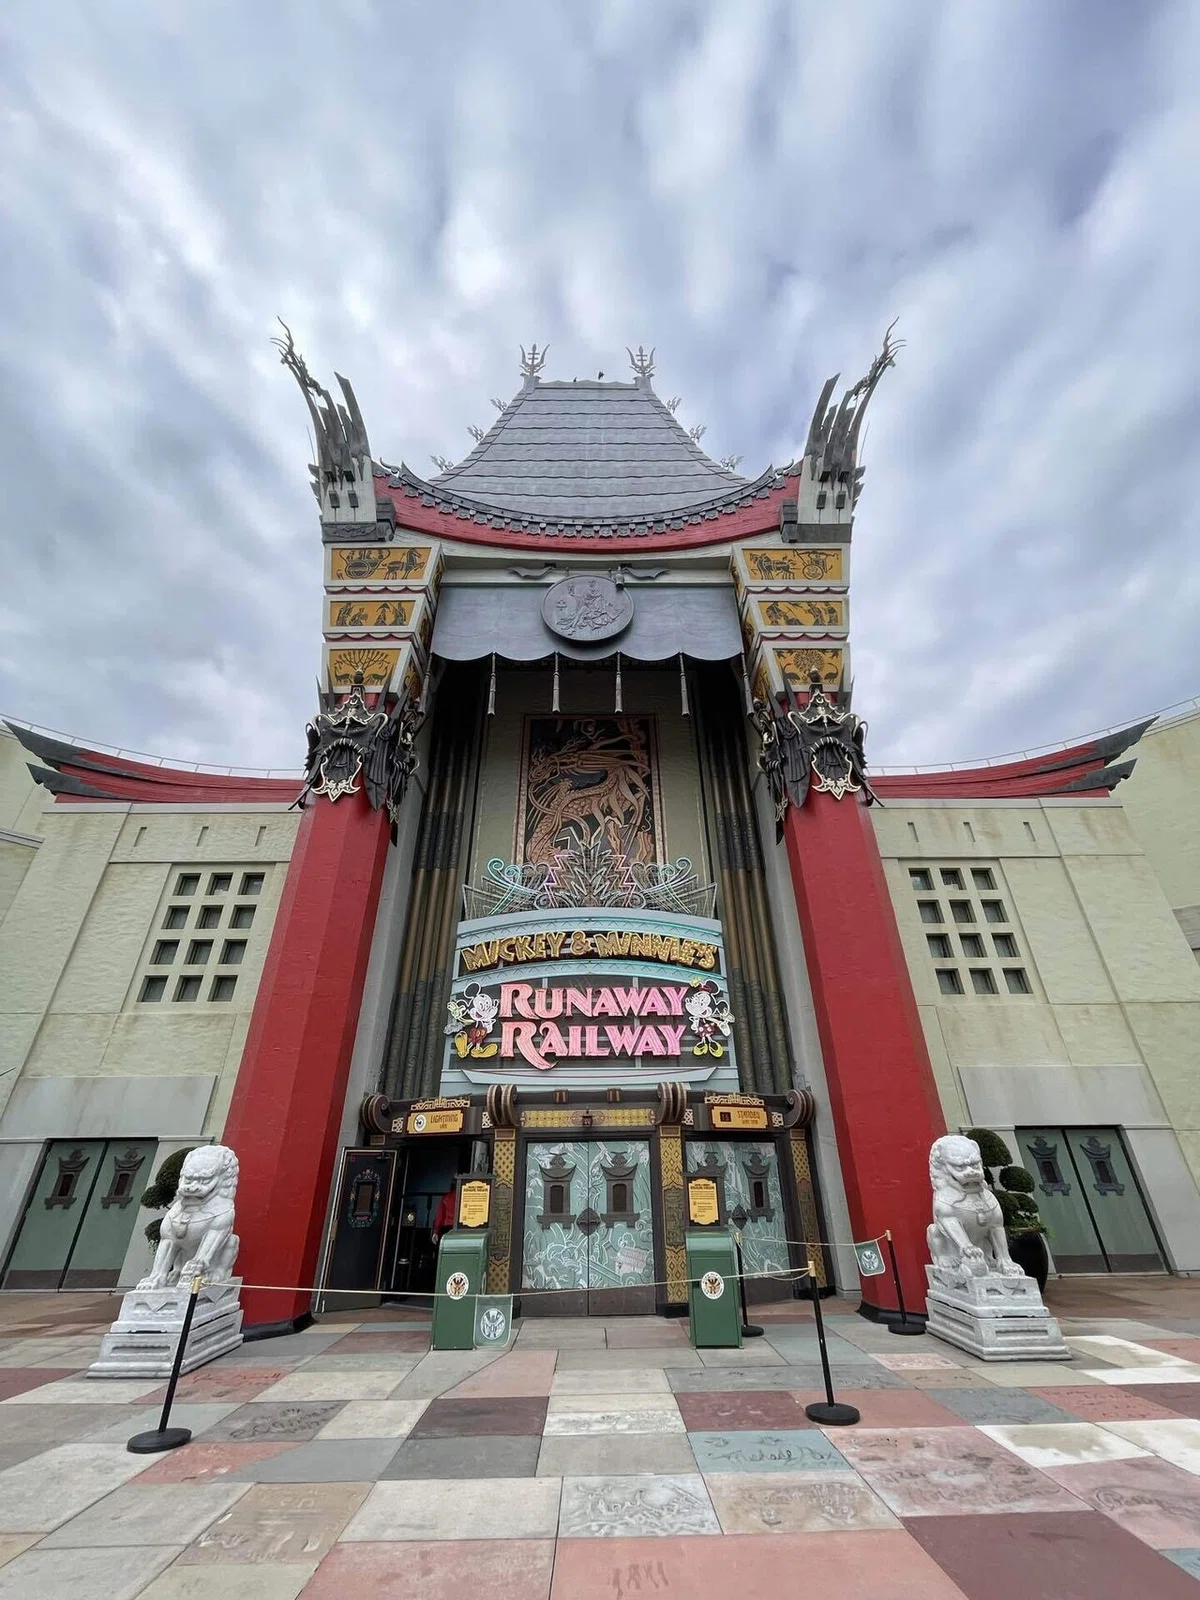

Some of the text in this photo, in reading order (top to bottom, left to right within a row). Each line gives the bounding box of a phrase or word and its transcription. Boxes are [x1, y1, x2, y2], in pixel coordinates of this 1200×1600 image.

[461, 930, 717, 970] MICKEY & MINNIE'S
[500, 983, 691, 1020] RUNAWAY
[500, 1021, 687, 1071] RAILWAY
